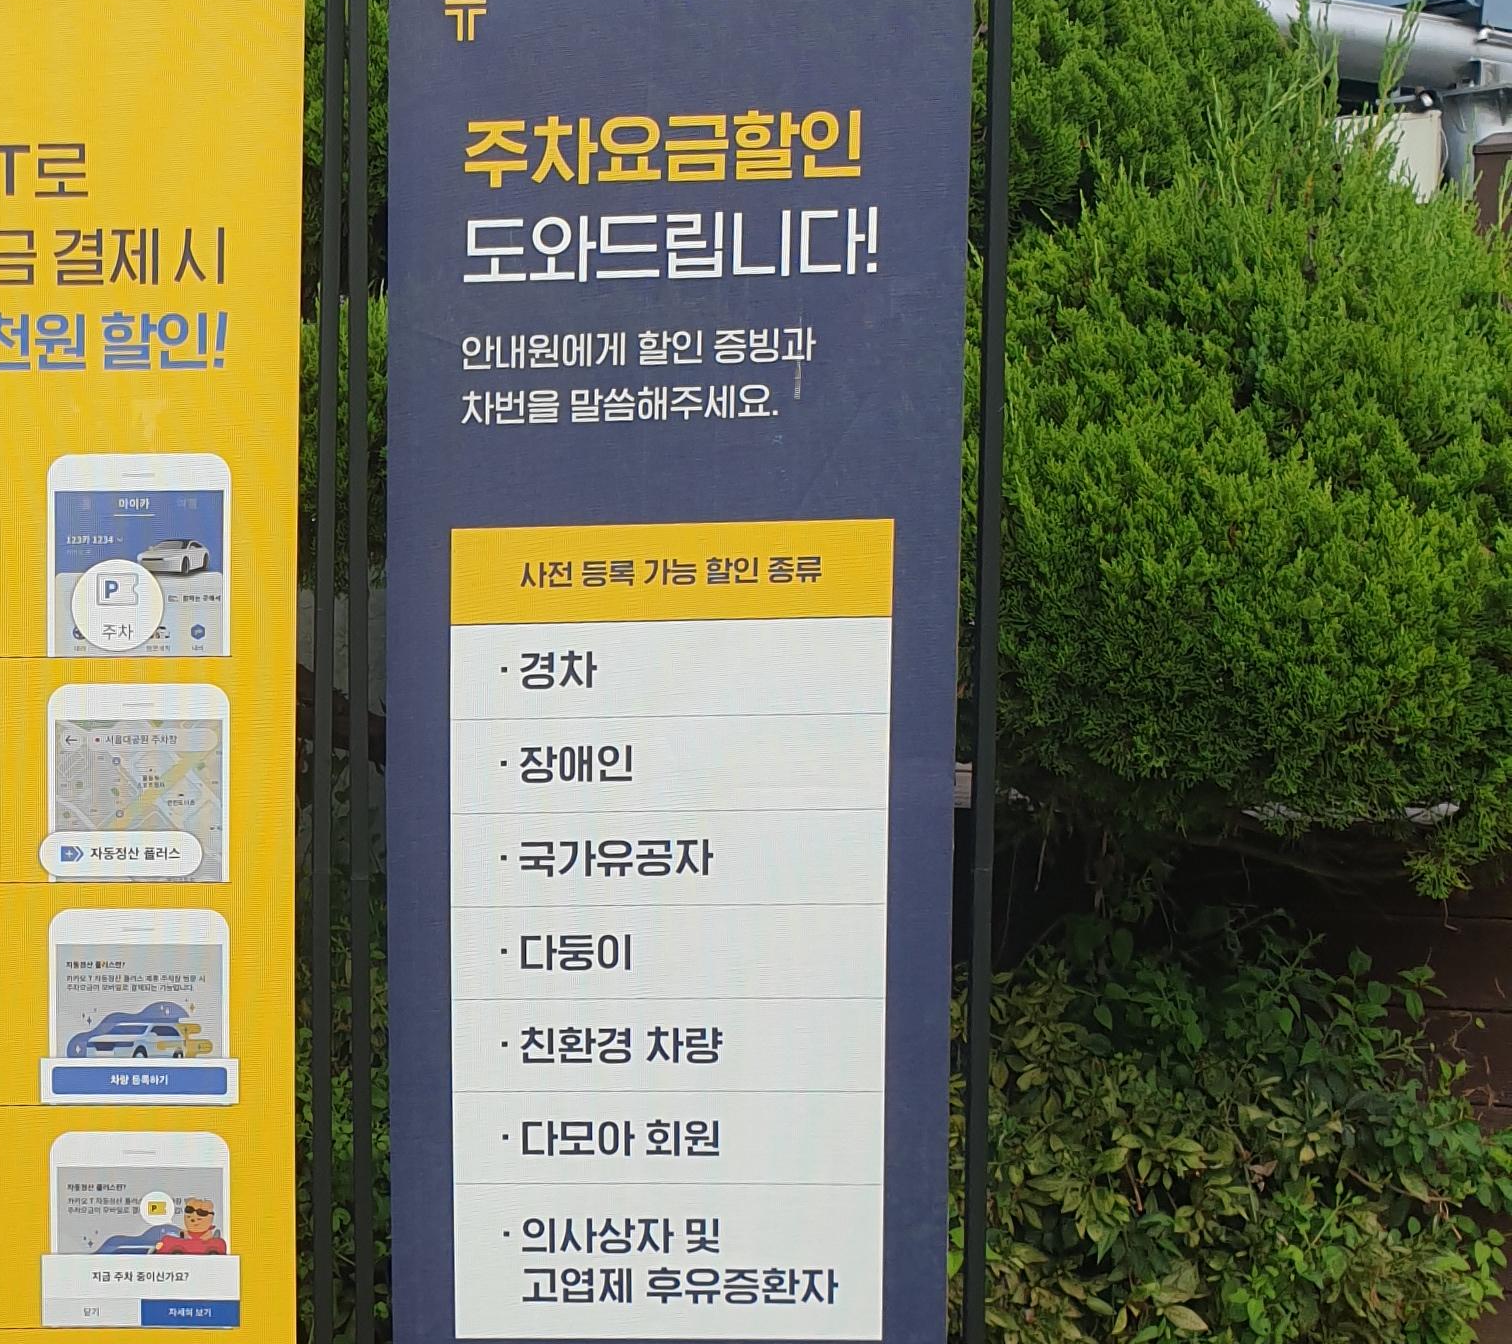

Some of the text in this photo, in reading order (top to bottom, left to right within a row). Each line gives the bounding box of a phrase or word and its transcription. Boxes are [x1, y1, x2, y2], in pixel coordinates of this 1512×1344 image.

[464, 109, 862, 188] 주차요금할인
[54, 228, 158, 286] 결제
[173, 227, 225, 285] 시
[463, 206, 879, 283] 도와드립니다!
[101, 311, 228, 370] 할인!
[461, 327, 816, 371] 안내원에게 할인 증빙과
[460, 385, 779, 425] 차번을 말씀해주세요.
[119, 497, 150, 509] 마이카
[105, 581, 118, 598] P
[520, 556, 823, 588] 사전 등록 가능 할인 종류
[102, 624, 133, 640] 주차
[519, 650, 598, 690] 경차
[519, 744, 633, 783] 장애인
[91, 847, 181, 862] 자동정산 플러스
[518, 838, 714, 878] 국가유공자
[520, 934, 632, 971] 다둥이
[520, 1027, 723, 1065] 친환경 차량
[110, 1074, 129, 1086] 차량
[521, 1120, 720, 1157] 다모아 회원
[521, 1218, 720, 1254] 의사상자 및
[92, 1272, 111, 1282] 지금
[114, 1272, 133, 1282] 주차
[521, 1267, 838, 1305] 고엽제 후유증환자
